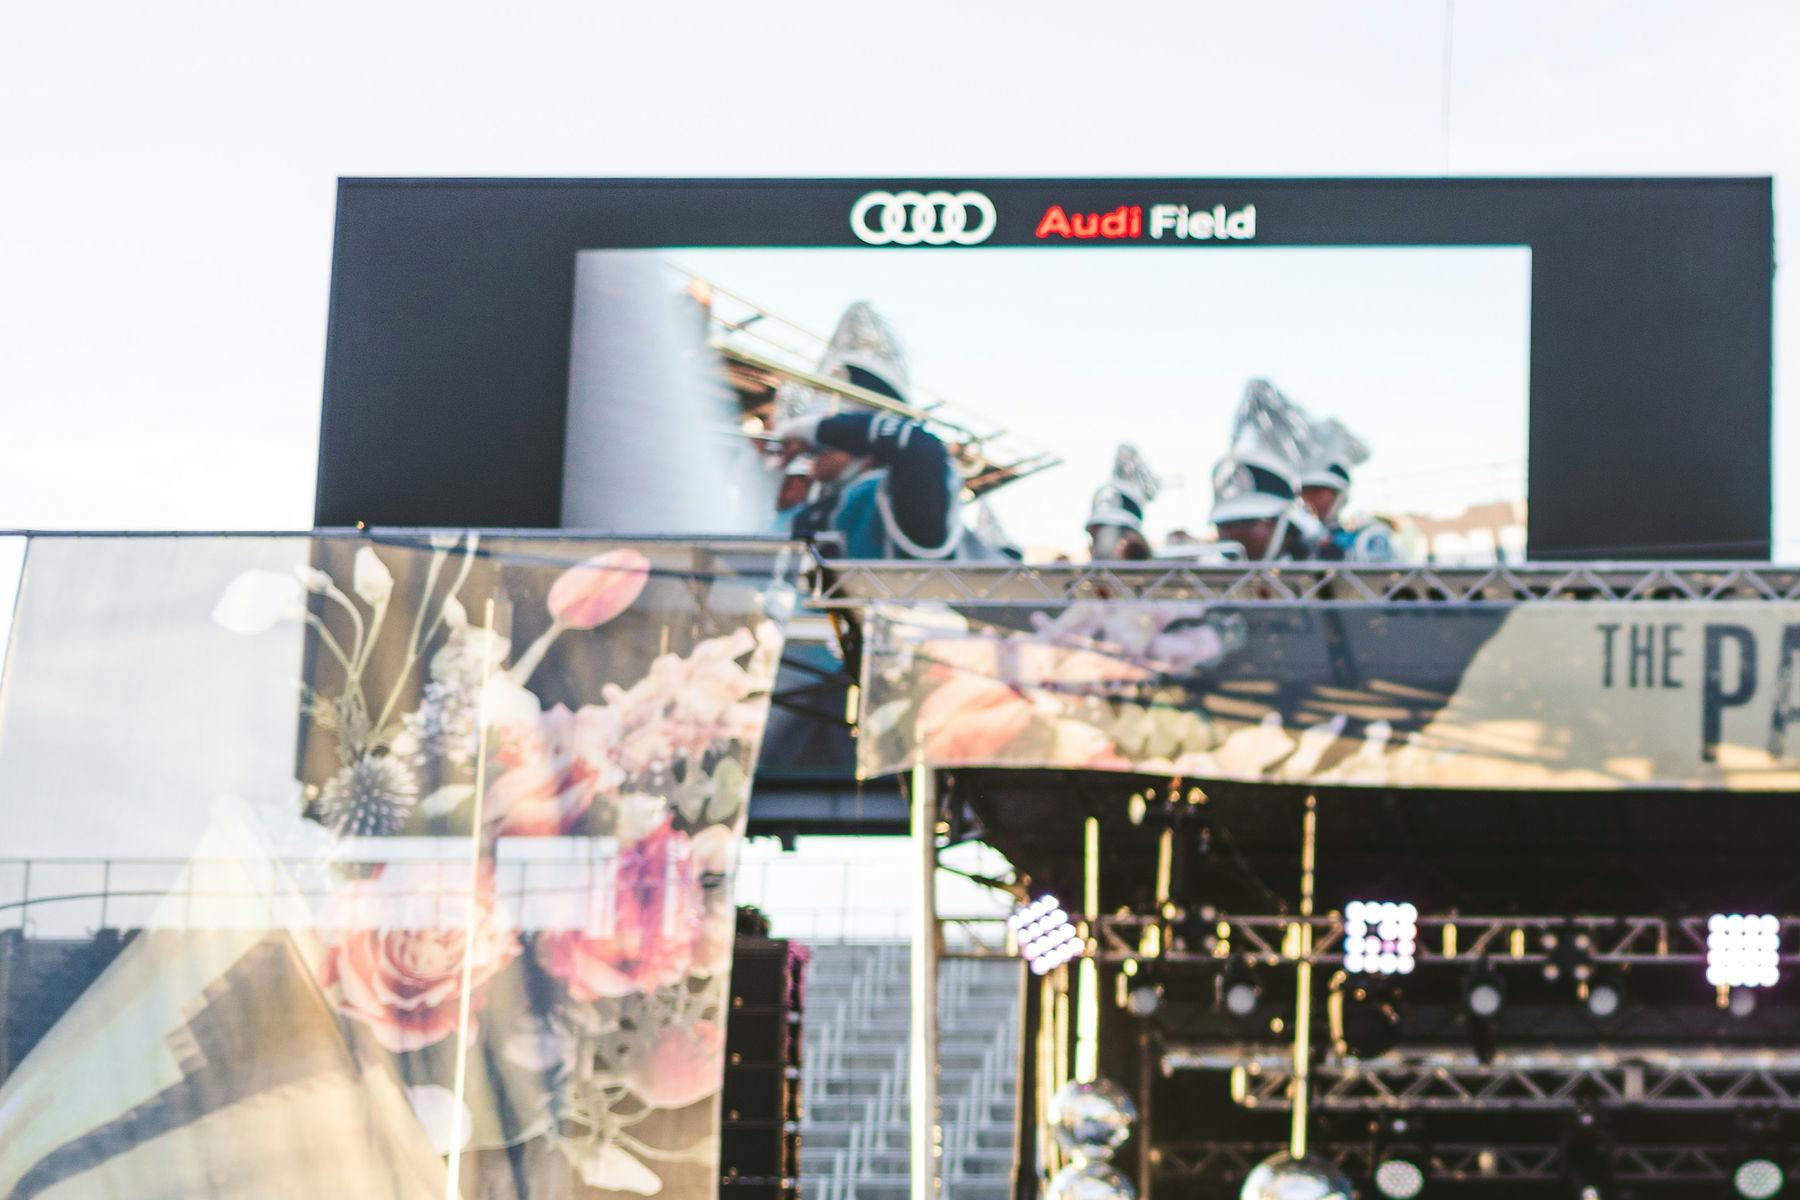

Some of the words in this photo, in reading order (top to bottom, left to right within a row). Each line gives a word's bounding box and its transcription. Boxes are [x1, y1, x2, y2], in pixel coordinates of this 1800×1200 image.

[1035, 204, 1142, 239] Audi
[1149, 204, 1257, 240] Field
[1596, 623, 1684, 688] THE
